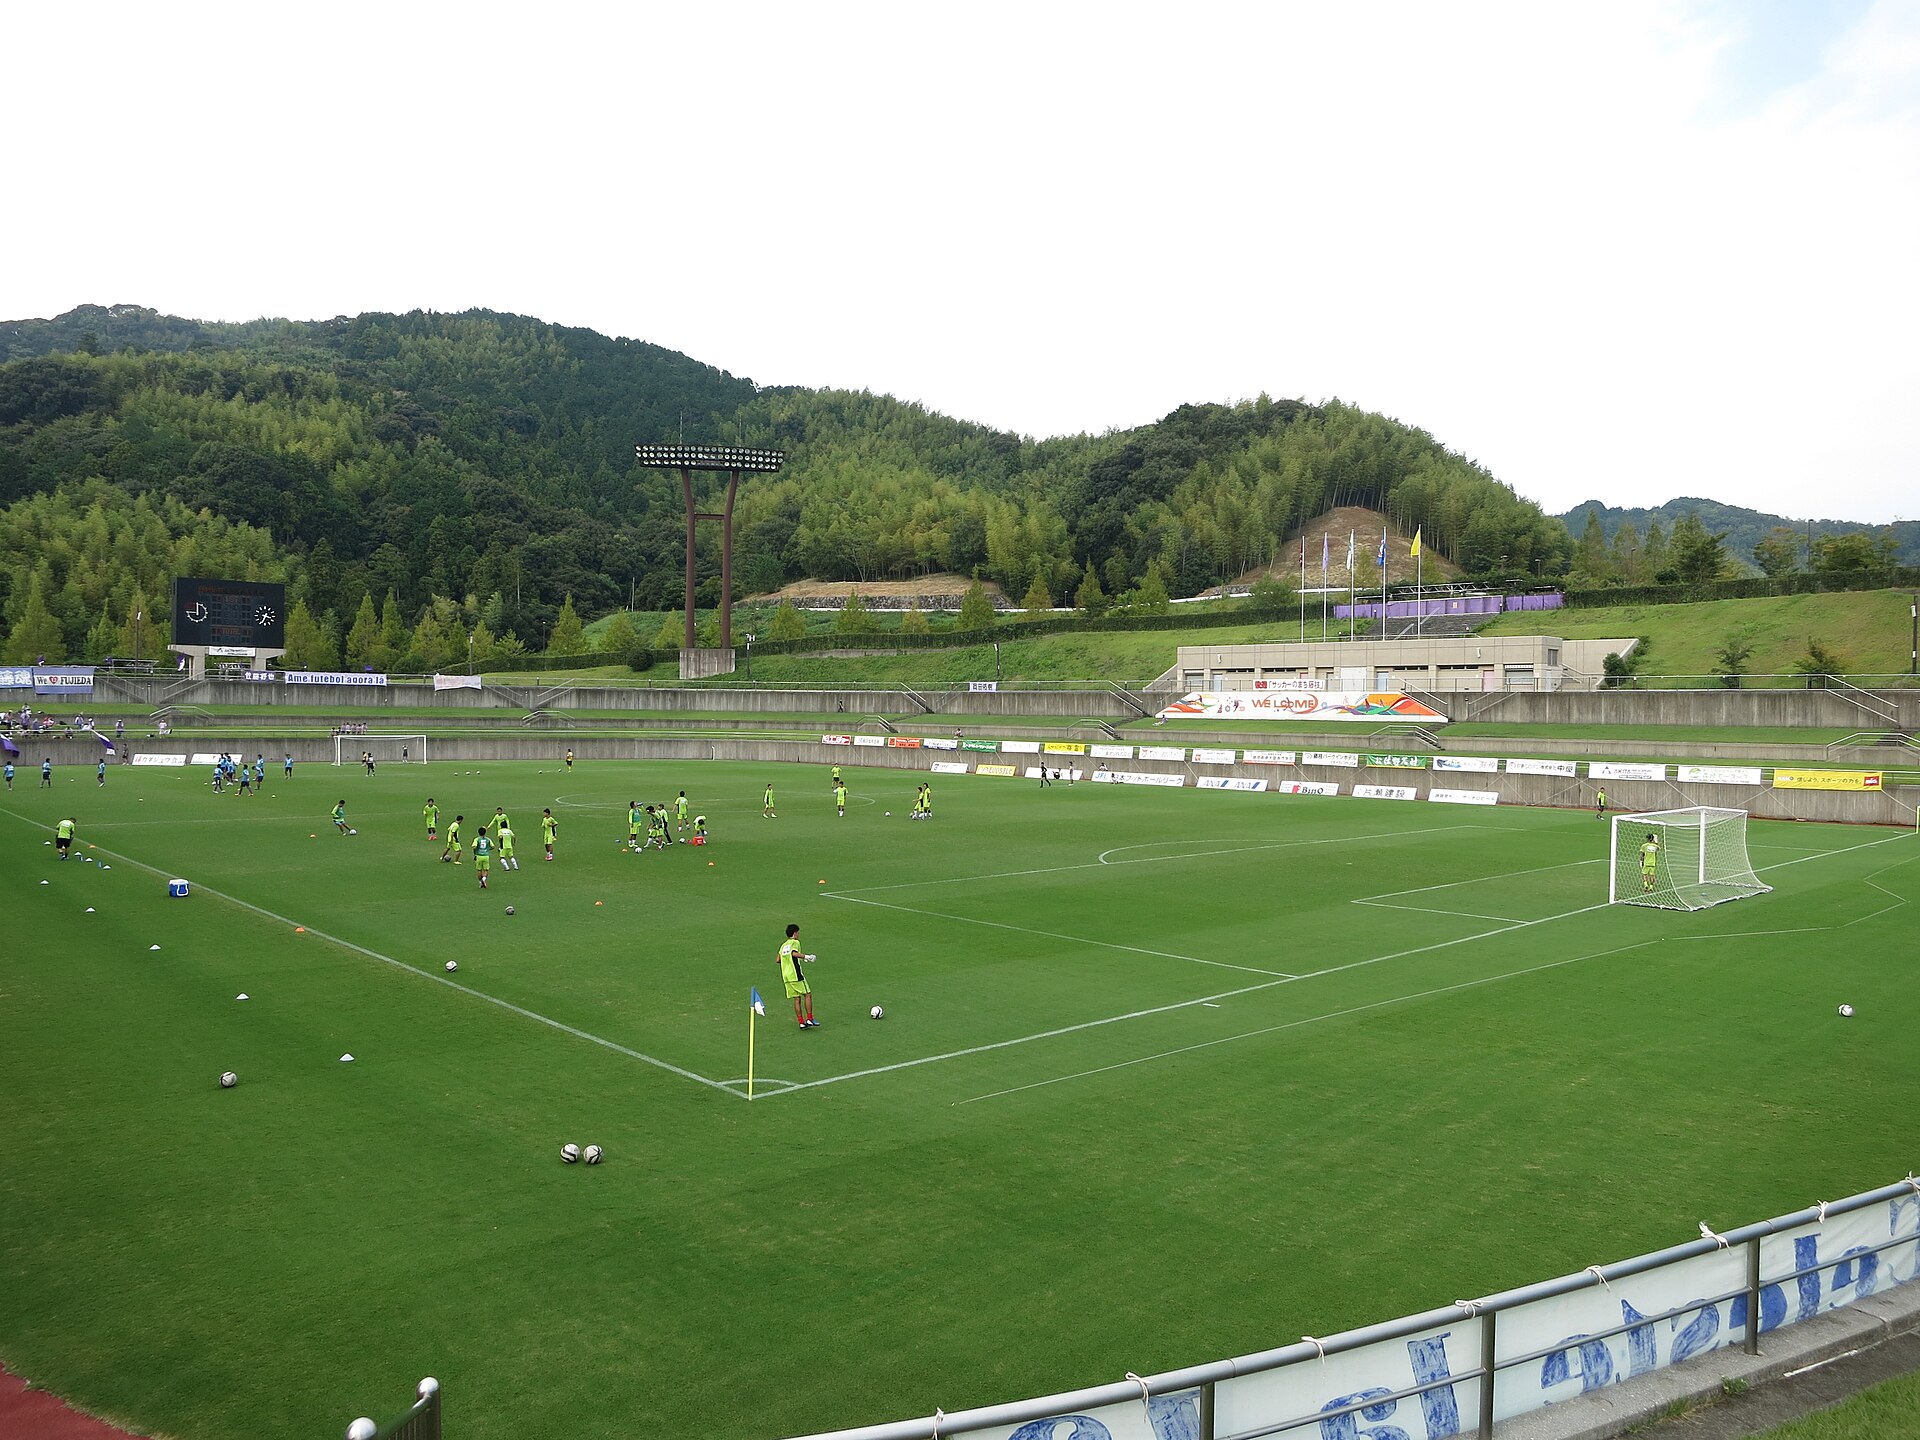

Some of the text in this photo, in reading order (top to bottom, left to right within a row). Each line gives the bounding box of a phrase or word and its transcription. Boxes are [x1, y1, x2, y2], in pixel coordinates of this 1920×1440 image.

[36, 676, 48, 685] We
[60, 676, 92, 685] FUJIEDA
[288, 674, 308, 684] Ame
[311, 674, 344, 684] futebol
[346, 676, 373, 686] agora
[1252, 698, 1315, 709] WELCOME
